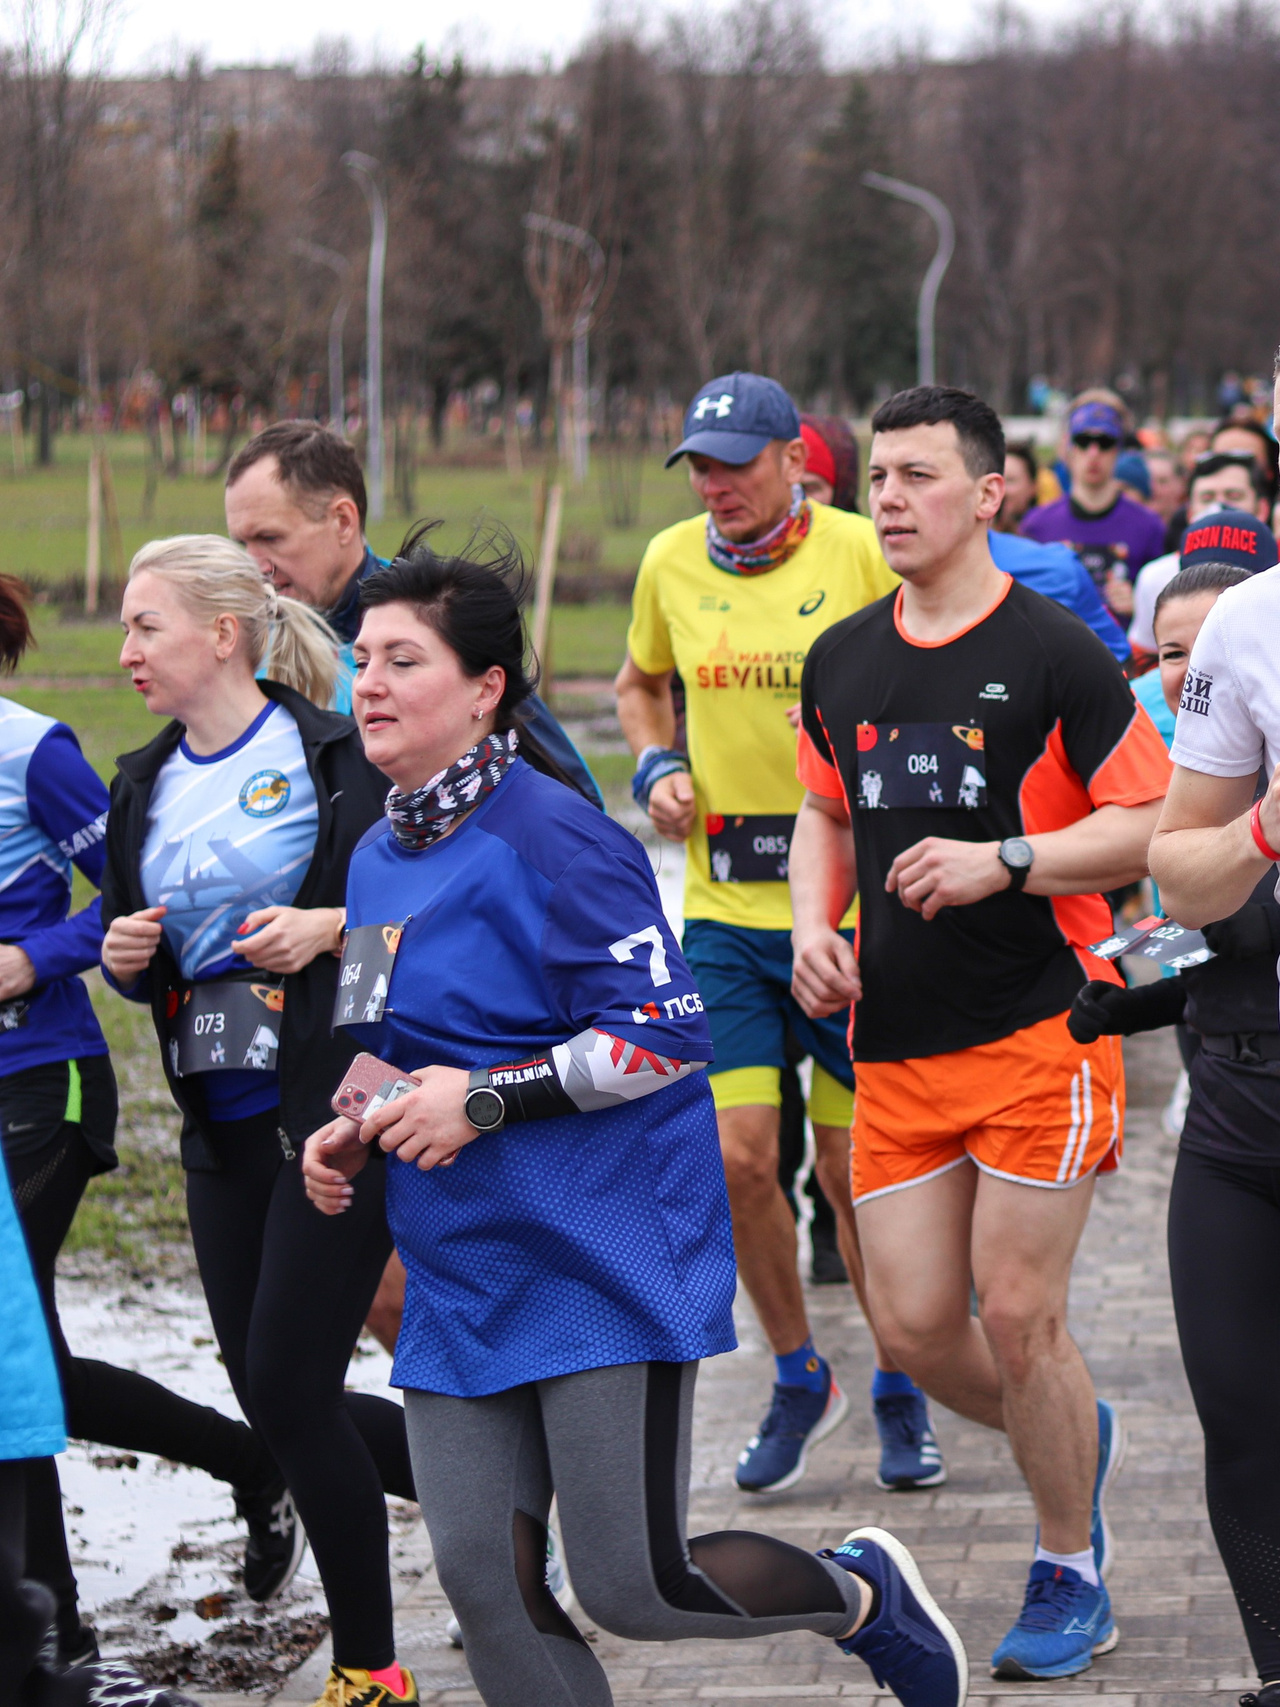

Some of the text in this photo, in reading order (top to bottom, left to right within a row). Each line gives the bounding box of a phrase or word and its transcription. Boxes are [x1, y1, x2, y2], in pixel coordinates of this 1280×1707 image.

[1221, 525, 1257, 555] RACE
[739, 651, 806, 663] MARATO
[696, 665, 801, 690] SEVILL
[907, 753, 939, 775] 084
[752, 834, 788, 856] 085
[1148, 926, 1185, 941] 022
[607, 924, 672, 988] 7
[340, 962, 363, 987] 064
[662, 992, 704, 1020] ПСБ
[194, 1012, 225, 1036] 073
